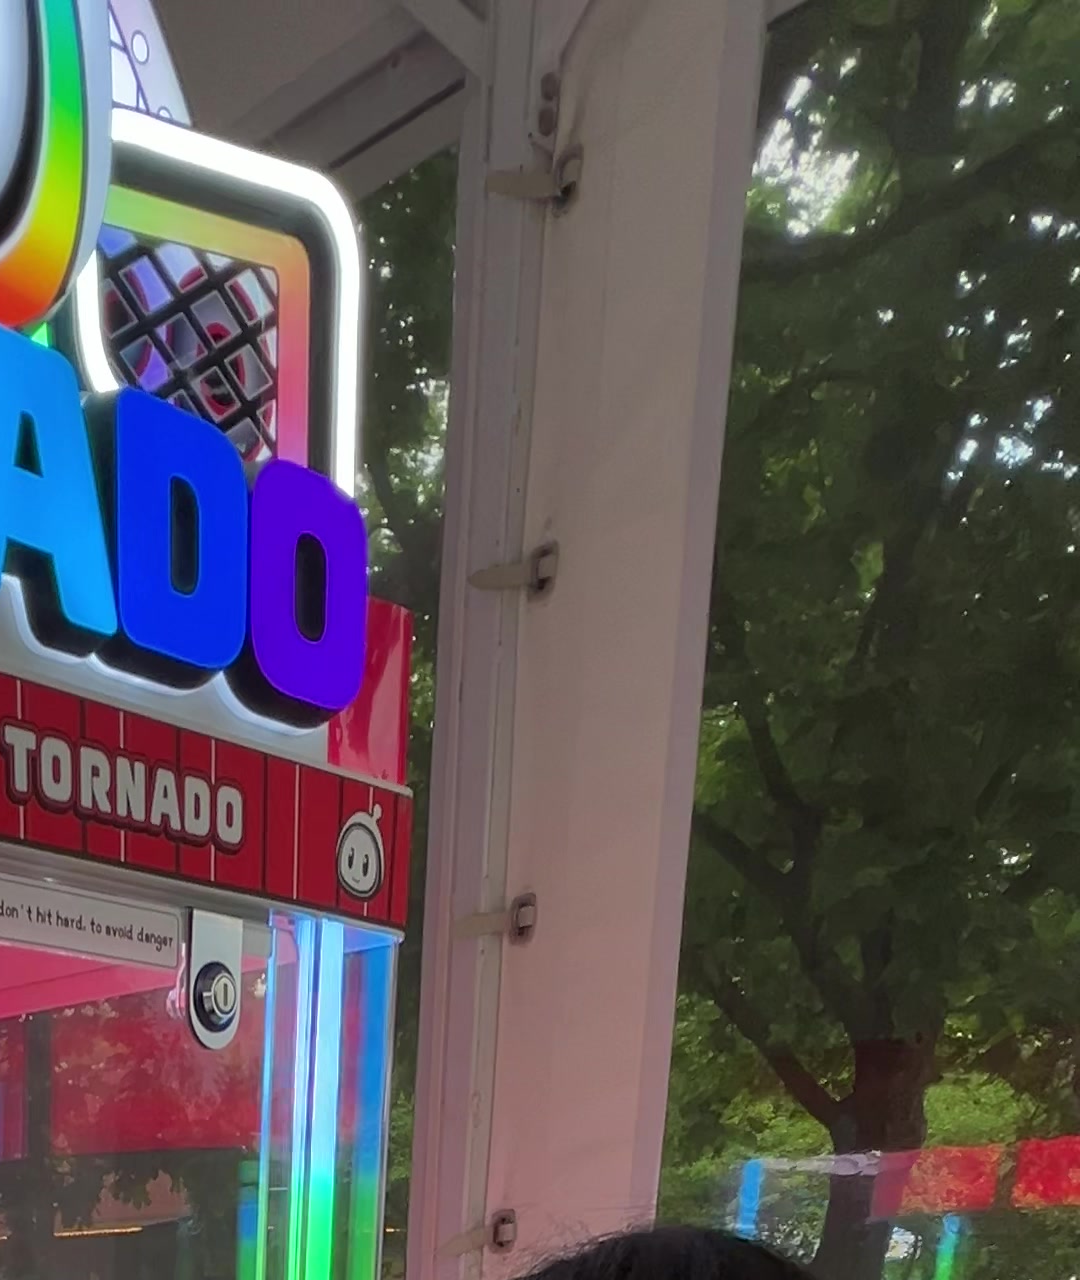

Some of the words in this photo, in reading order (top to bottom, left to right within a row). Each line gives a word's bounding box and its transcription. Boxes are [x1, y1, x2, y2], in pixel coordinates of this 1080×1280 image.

[4, 724, 243, 845] TORNADO
[36, 906, 52, 926] hit
[90, 918, 102, 934] to
[105, 924, 133, 940] avoid
[137, 927, 173, 952] danger
